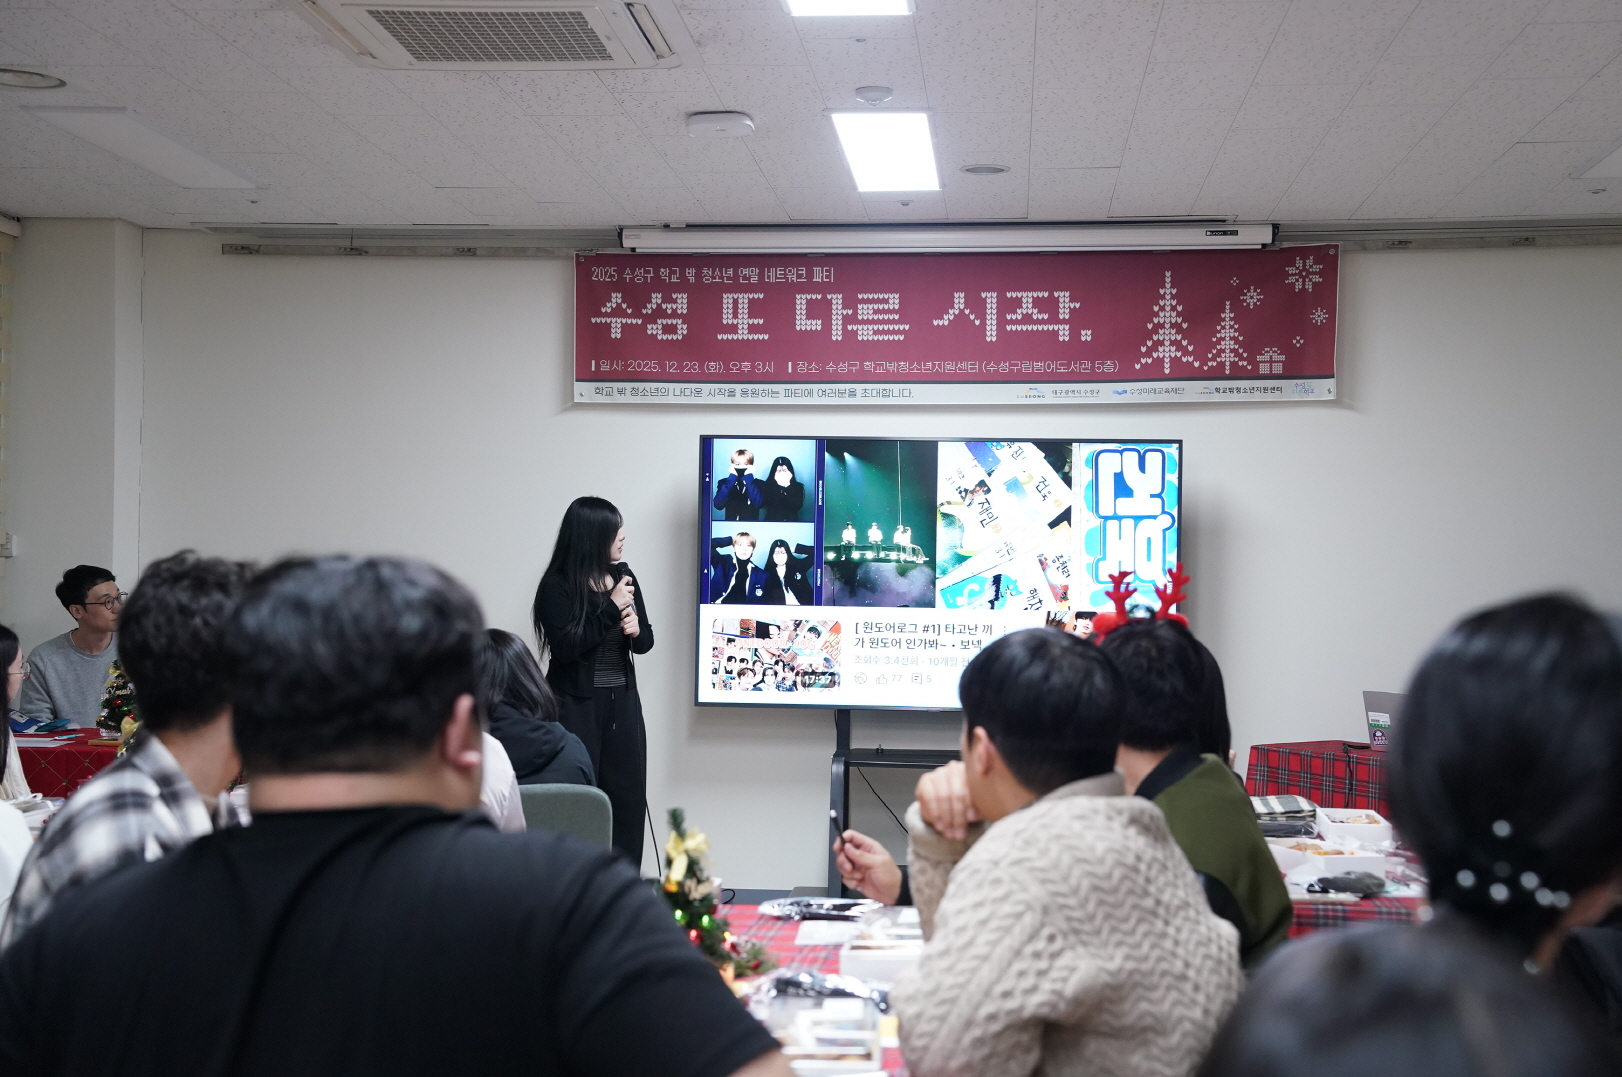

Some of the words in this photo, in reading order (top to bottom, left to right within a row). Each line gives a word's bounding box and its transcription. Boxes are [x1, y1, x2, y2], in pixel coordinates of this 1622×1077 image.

[591, 266, 618, 281] 2025
[623, 267, 654, 283] 수성구
[659, 267, 681, 283] 학교
[685, 267, 696, 283] 밖
[701, 267, 734, 283] 청소년
[738, 267, 759, 283] 연말
[764, 267, 807, 283] 네트워크
[812, 267, 834, 283] 파티
[591, 292, 688, 341] 수성
[717, 292, 769, 341] 또
[795, 292, 910, 341] 다른
[933, 291, 1092, 342] 시작.
[599, 359, 625, 371] 일시:
[627, 360, 661, 372] 2025.
[665, 361, 680, 373] 12.
[683, 361, 701, 373] 23.
[704, 361, 726, 374] (화).
[729, 361, 752, 374] 오후
[755, 361, 774, 374] 3시
[796, 361, 822, 374] 장소:
[825, 361, 860, 374] 수성구
[863, 360, 979, 374] 학교밖청소년지원센터
[982, 360, 1092, 374] (수성구립범어도서관
[1094, 360, 1119, 373] 5층)
[594, 386, 614, 397] 학교
[616, 386, 628, 397] 밖
[629, 386, 670, 398] 청소년의
[672, 387, 703, 398] 나다운
[706, 387, 737, 398] 시작을
[740, 387, 780, 399] 응원하는
[783, 388, 814, 399] 파티에
[816, 388, 857, 399] 여러분을
[860, 388, 914, 399] 초대합니다.
[1129, 387, 1185, 396] 수성미래교육재단
[1215, 386, 1283, 394] 학교밖청소년지원센터
[863, 621, 918, 634] 원도어로그
[922, 624, 941, 636] #1]
[945, 623, 978, 636] 타고난
[982, 624, 993, 635] 끼
[854, 637, 865, 649] 가
[868, 637, 901, 650] 원도어
[854, 655, 881, 666] 조회수
[928, 656, 958, 668] 10개월
[891, 674, 902, 683] 77
